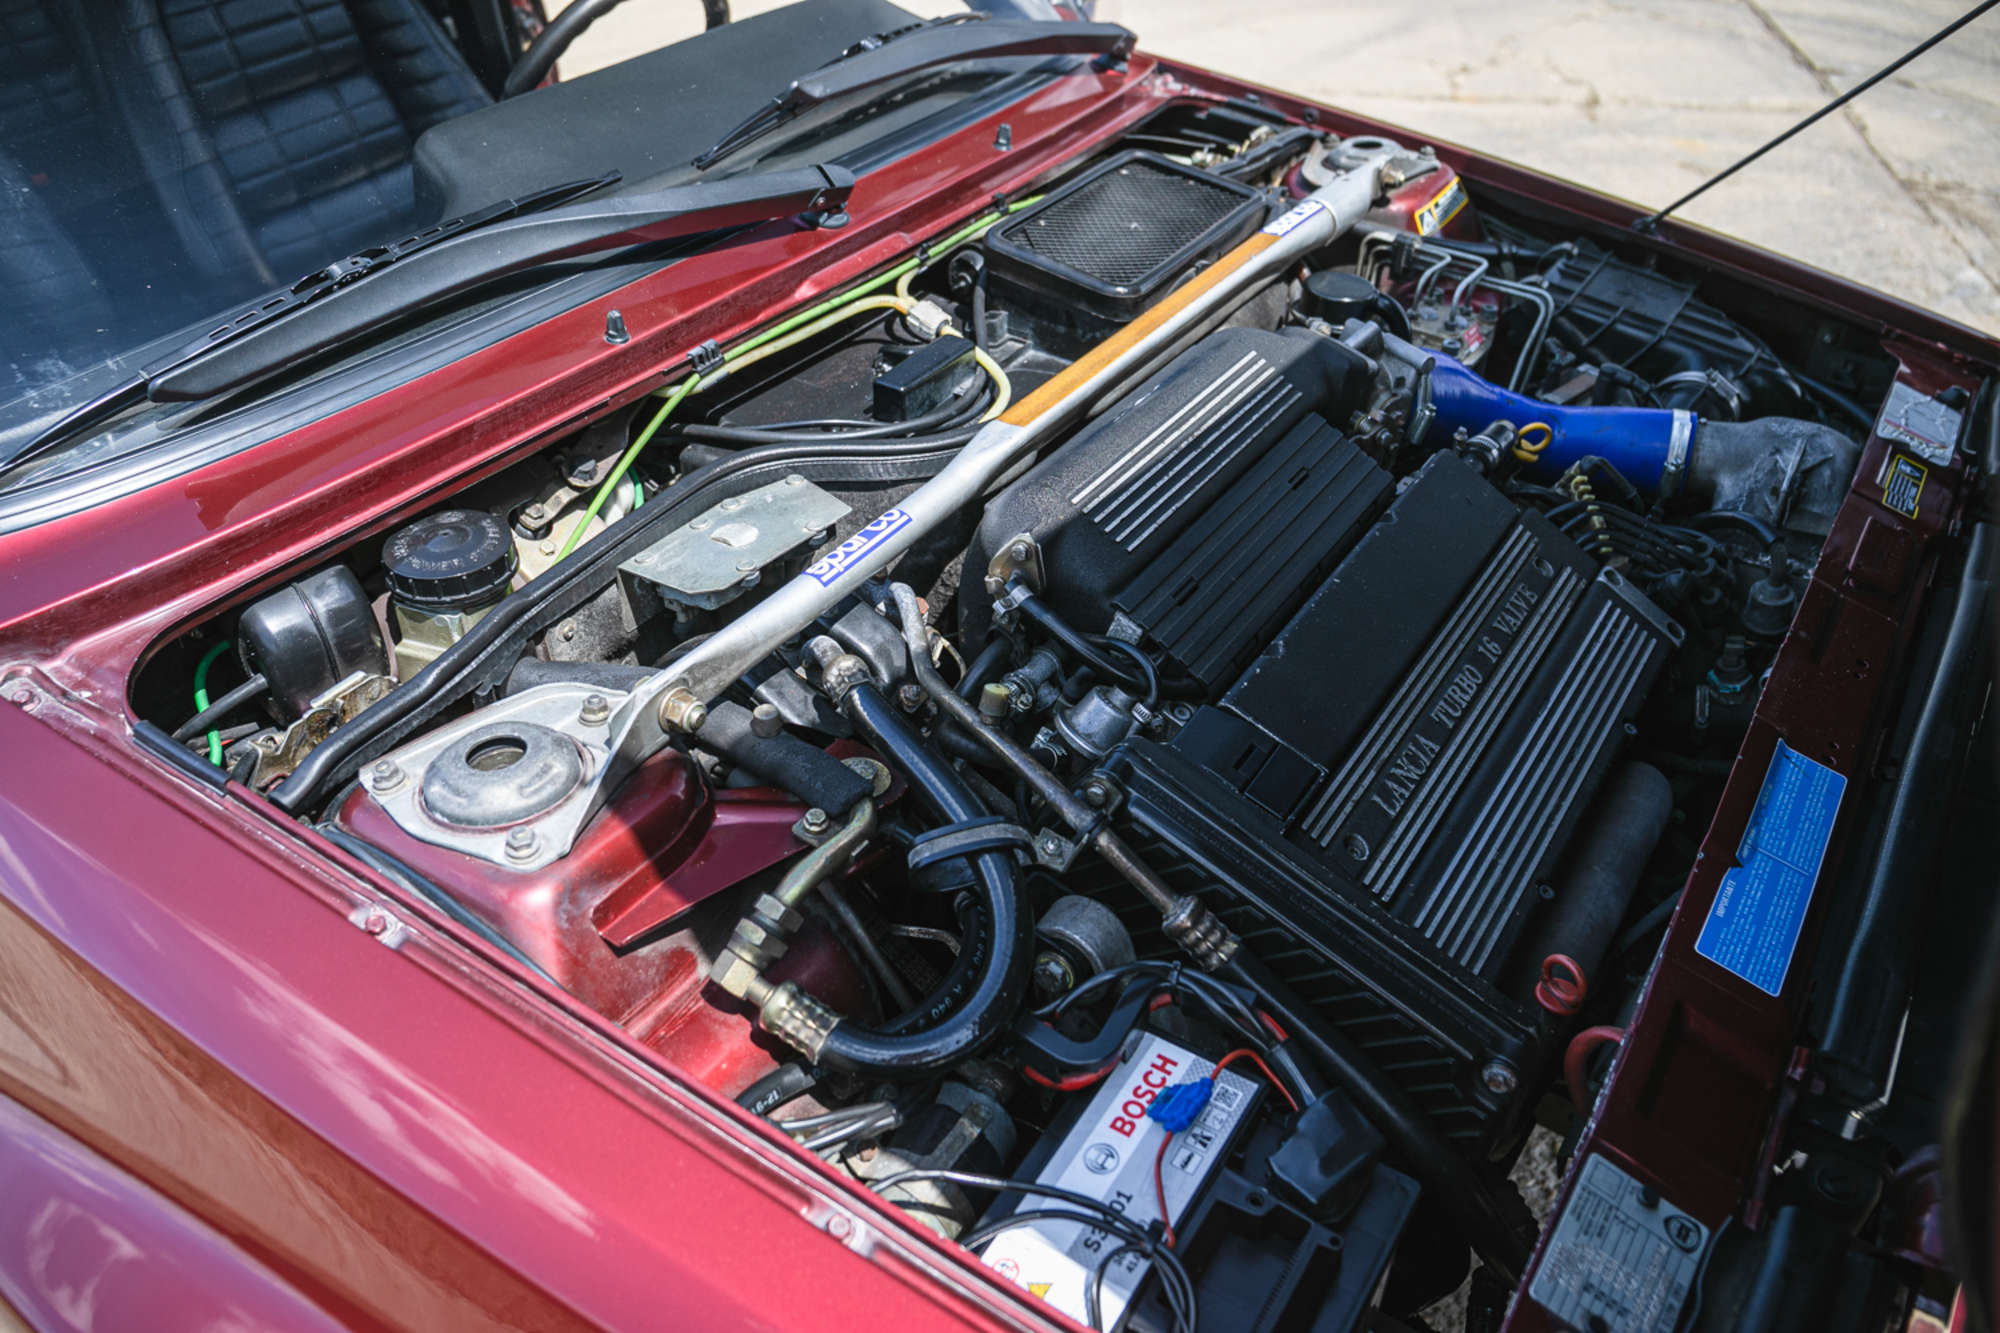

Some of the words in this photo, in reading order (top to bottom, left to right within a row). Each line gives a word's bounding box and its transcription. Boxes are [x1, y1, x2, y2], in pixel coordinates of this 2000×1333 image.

[806, 509, 901, 573] sparco
[1372, 734, 1440, 817] LANCIA
[1432, 664, 1483, 728] TURBO
[1477, 637, 1502, 662] 16
[1493, 583, 1538, 635] VALVE
[1109, 1053, 1178, 1137] BOSCH
